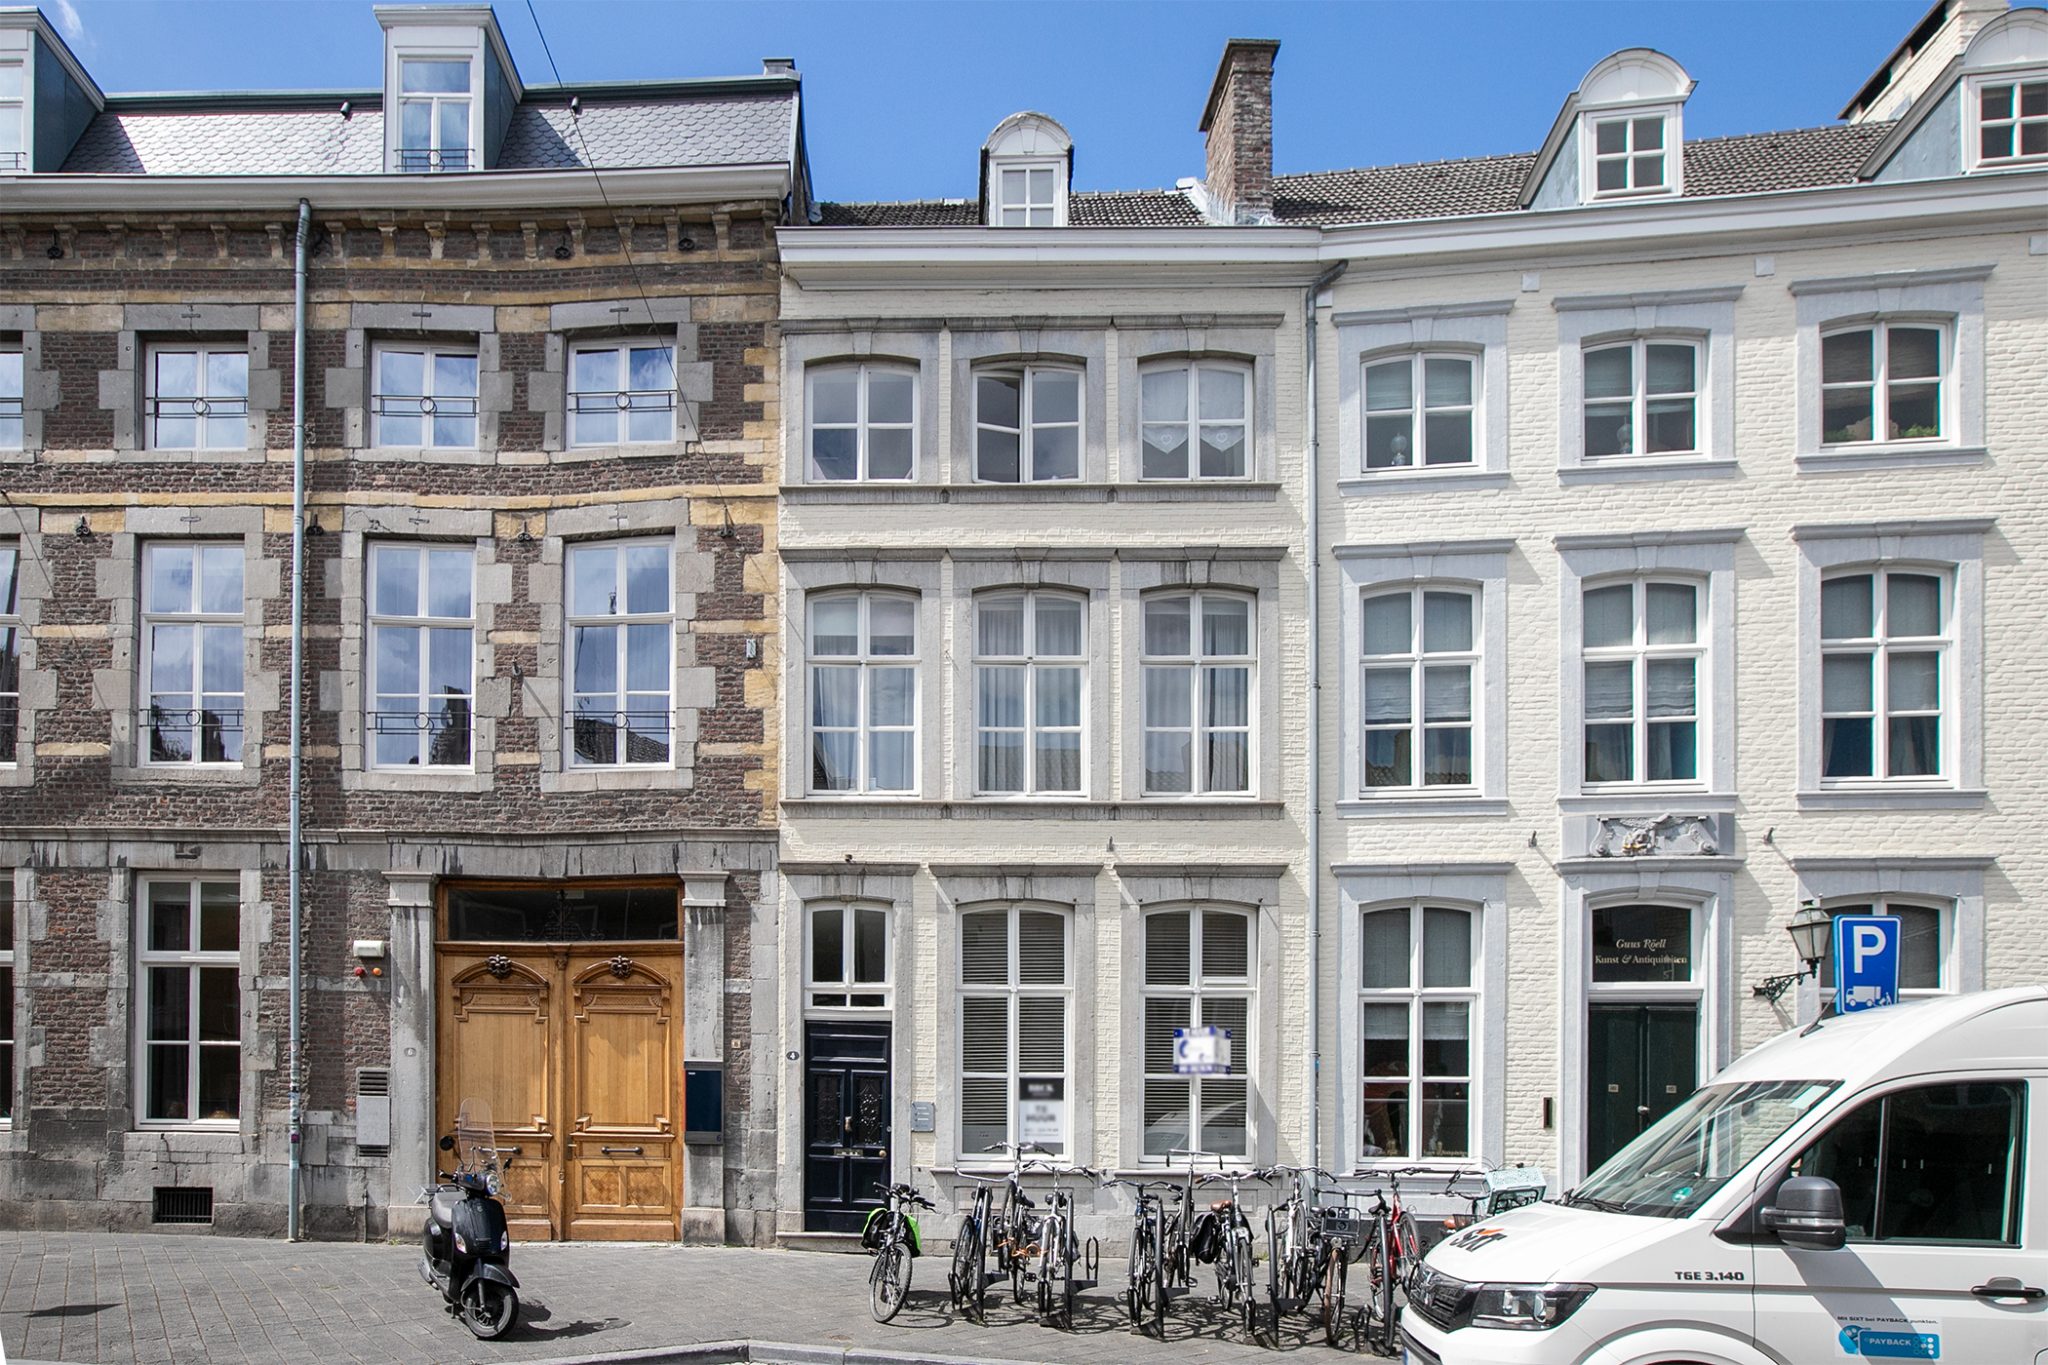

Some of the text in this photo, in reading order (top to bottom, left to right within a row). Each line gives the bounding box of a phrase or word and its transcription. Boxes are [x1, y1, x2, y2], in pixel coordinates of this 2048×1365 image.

[1616, 939, 1666, 951] Guus Röell
[1853, 925, 1886, 973] P
[1595, 955, 1619, 964] Kunst
[1622, 954, 1632, 963] &
[1675, 1271, 1744, 1281] TGE 3.140
[1869, 1337, 1911, 1346] PAYBACK
